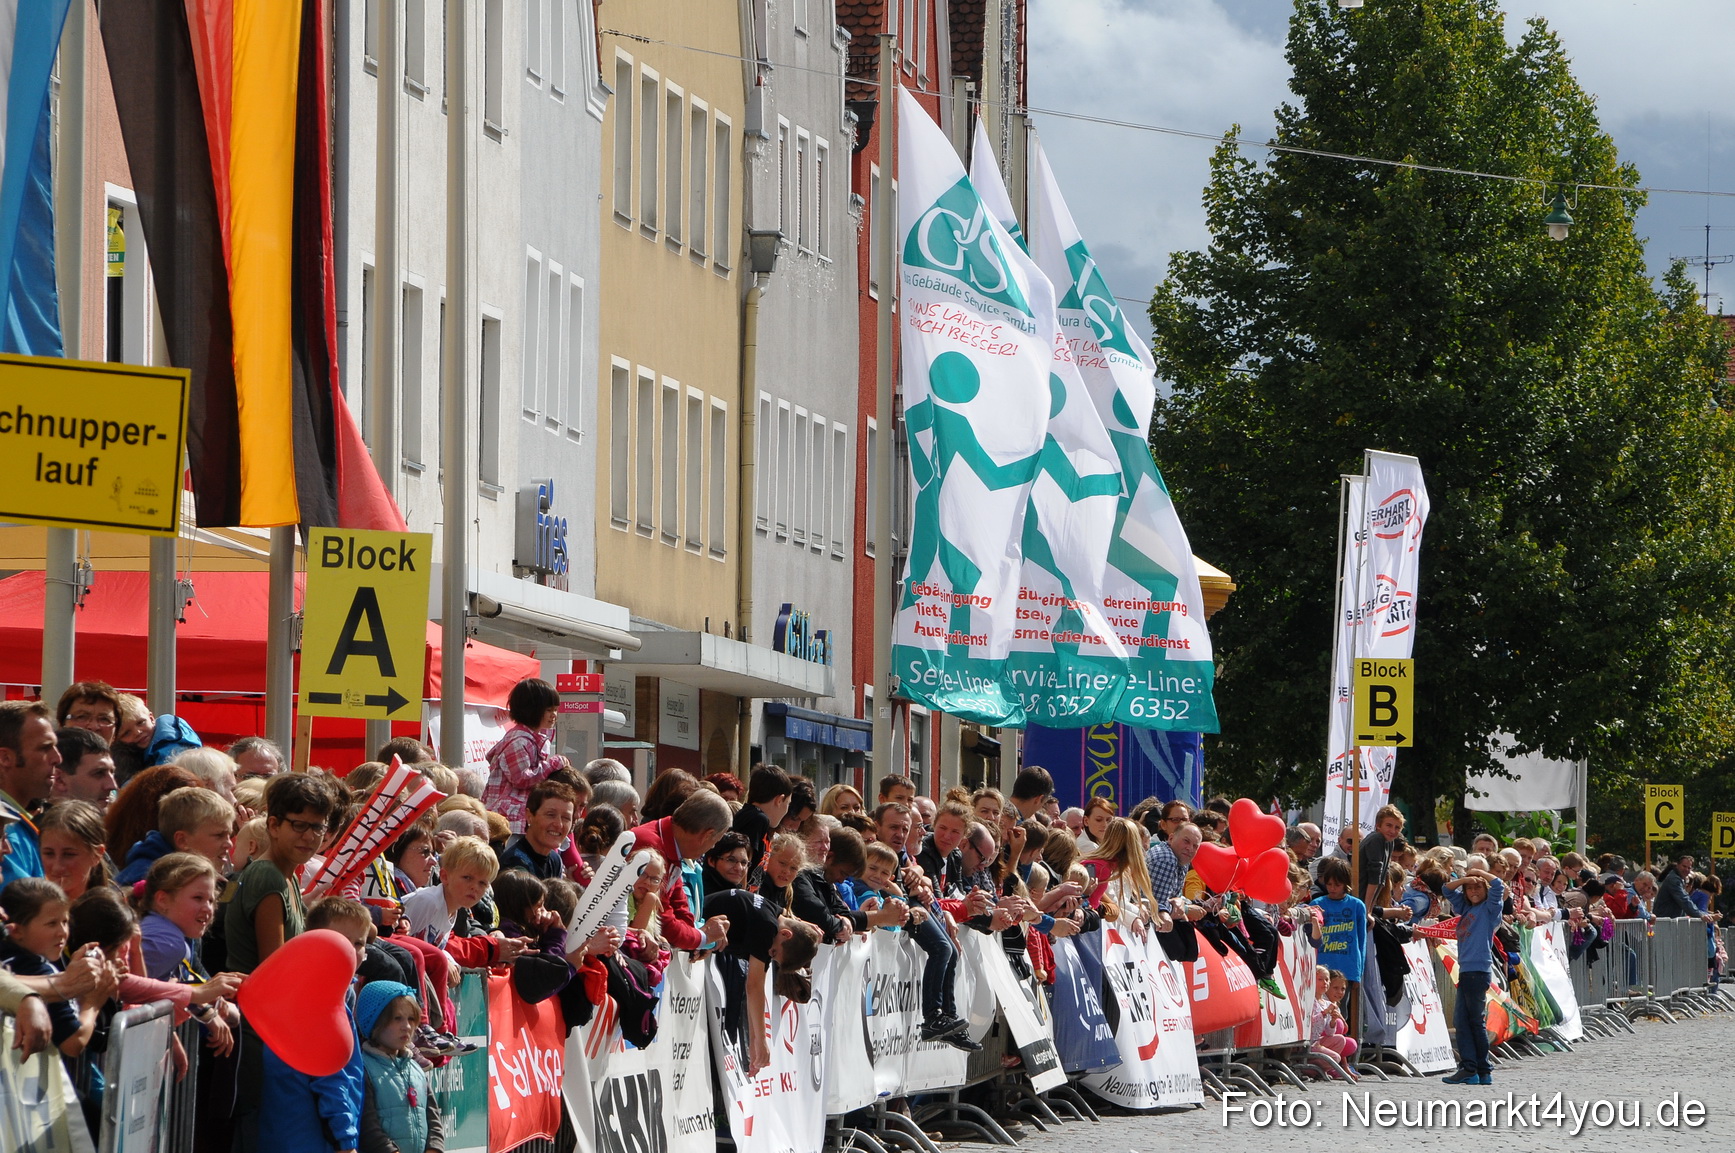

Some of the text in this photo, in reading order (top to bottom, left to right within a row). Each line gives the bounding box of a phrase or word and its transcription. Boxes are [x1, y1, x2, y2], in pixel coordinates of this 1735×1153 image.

[912, 273, 961, 298] Gebäude
[964, 291, 999, 315] Service
[1003, 311, 1036, 334] GmbH
[948, 326, 1018, 356] BESSER!
[1109, 353, 1143, 372] GmbH
[35, 452, 99, 487] lauf
[322, 535, 417, 572] Block
[1103, 595, 1188, 616] dereinigung
[325, 586, 397, 678] A
[1129, 669, 1202, 694] e-Line:
[1361, 662, 1407, 677] Block
[564, 702, 589, 710] HotSpot
[1130, 696, 1190, 719] 6352
[1369, 685, 1398, 727] B
[1650, 787, 1679, 797] Block
[1655, 801, 1674, 828] C
[1716, 814, 1735, 823] Bloc
